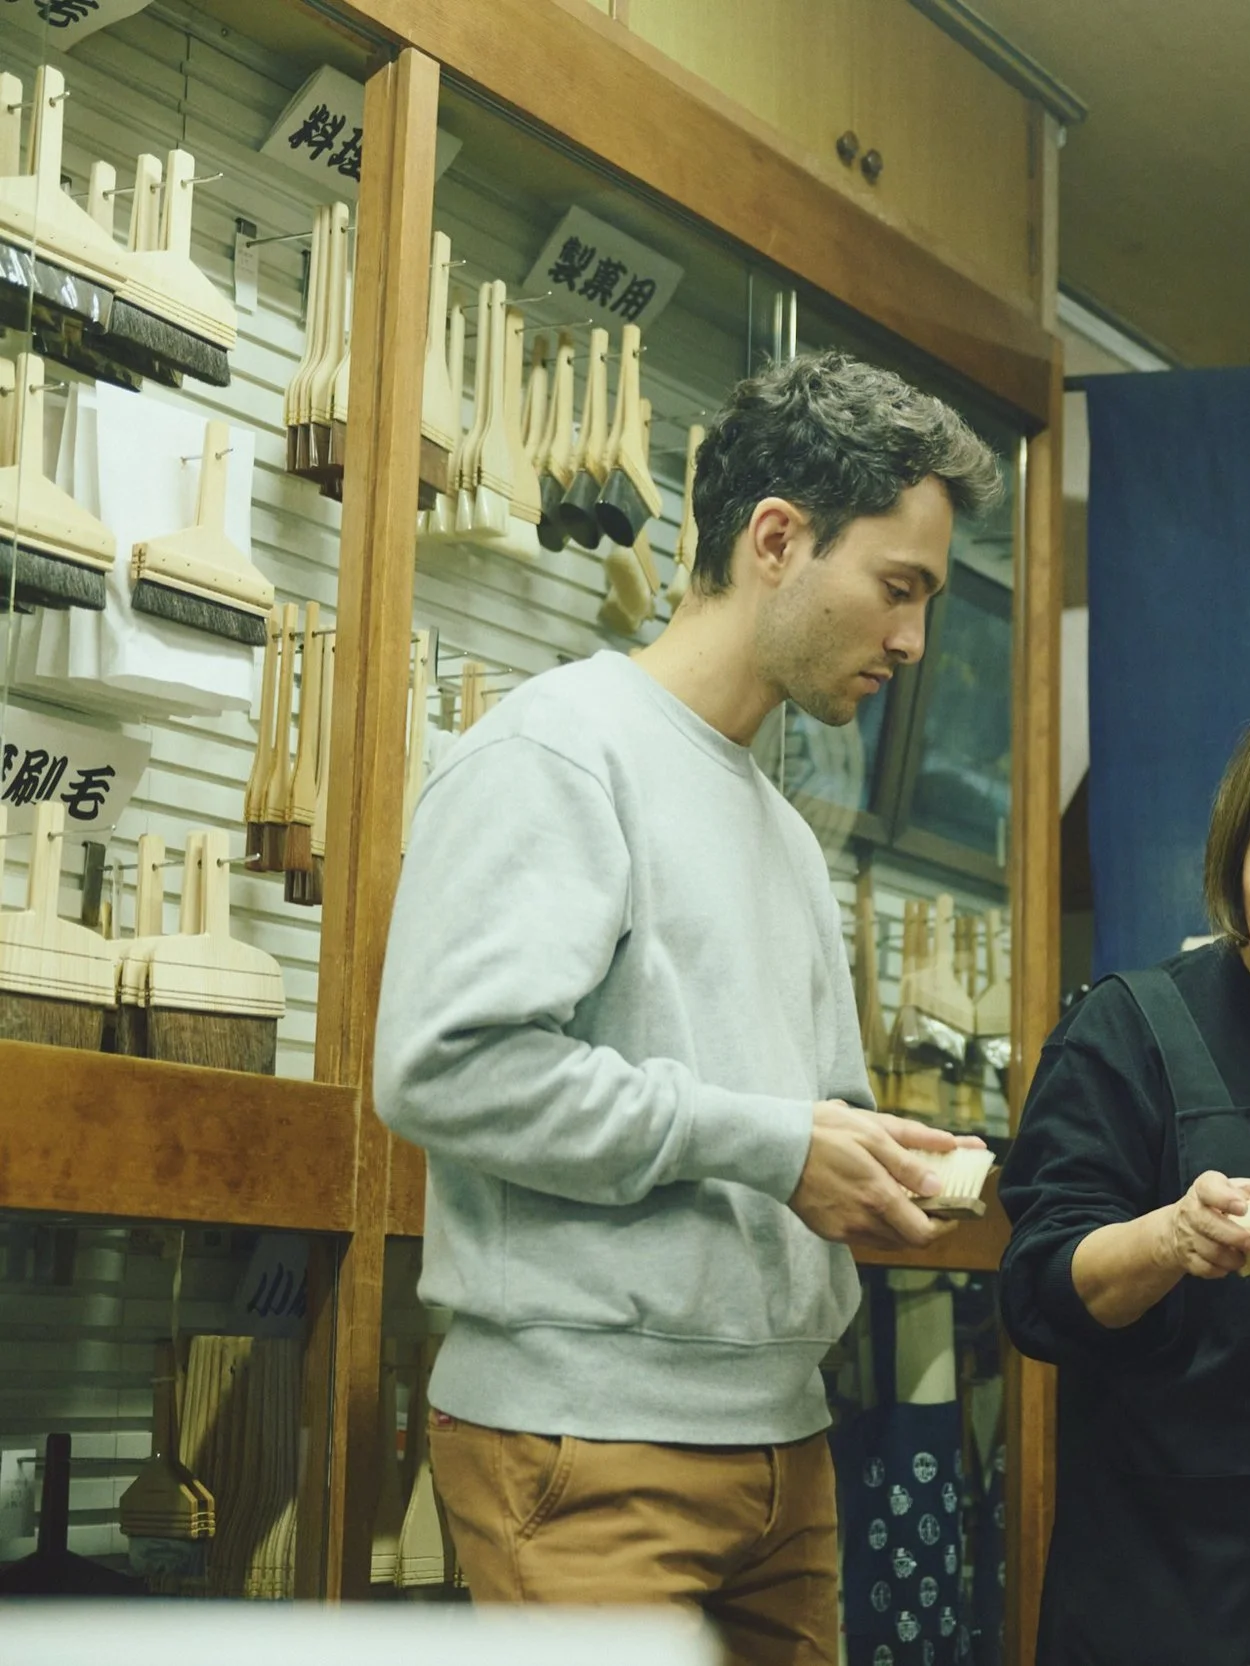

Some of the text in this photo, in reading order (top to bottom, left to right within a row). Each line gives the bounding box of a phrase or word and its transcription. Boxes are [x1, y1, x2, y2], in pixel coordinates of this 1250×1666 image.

[548, 235, 657, 322] 製菓用
[1, 743, 116, 821] 刷毛
